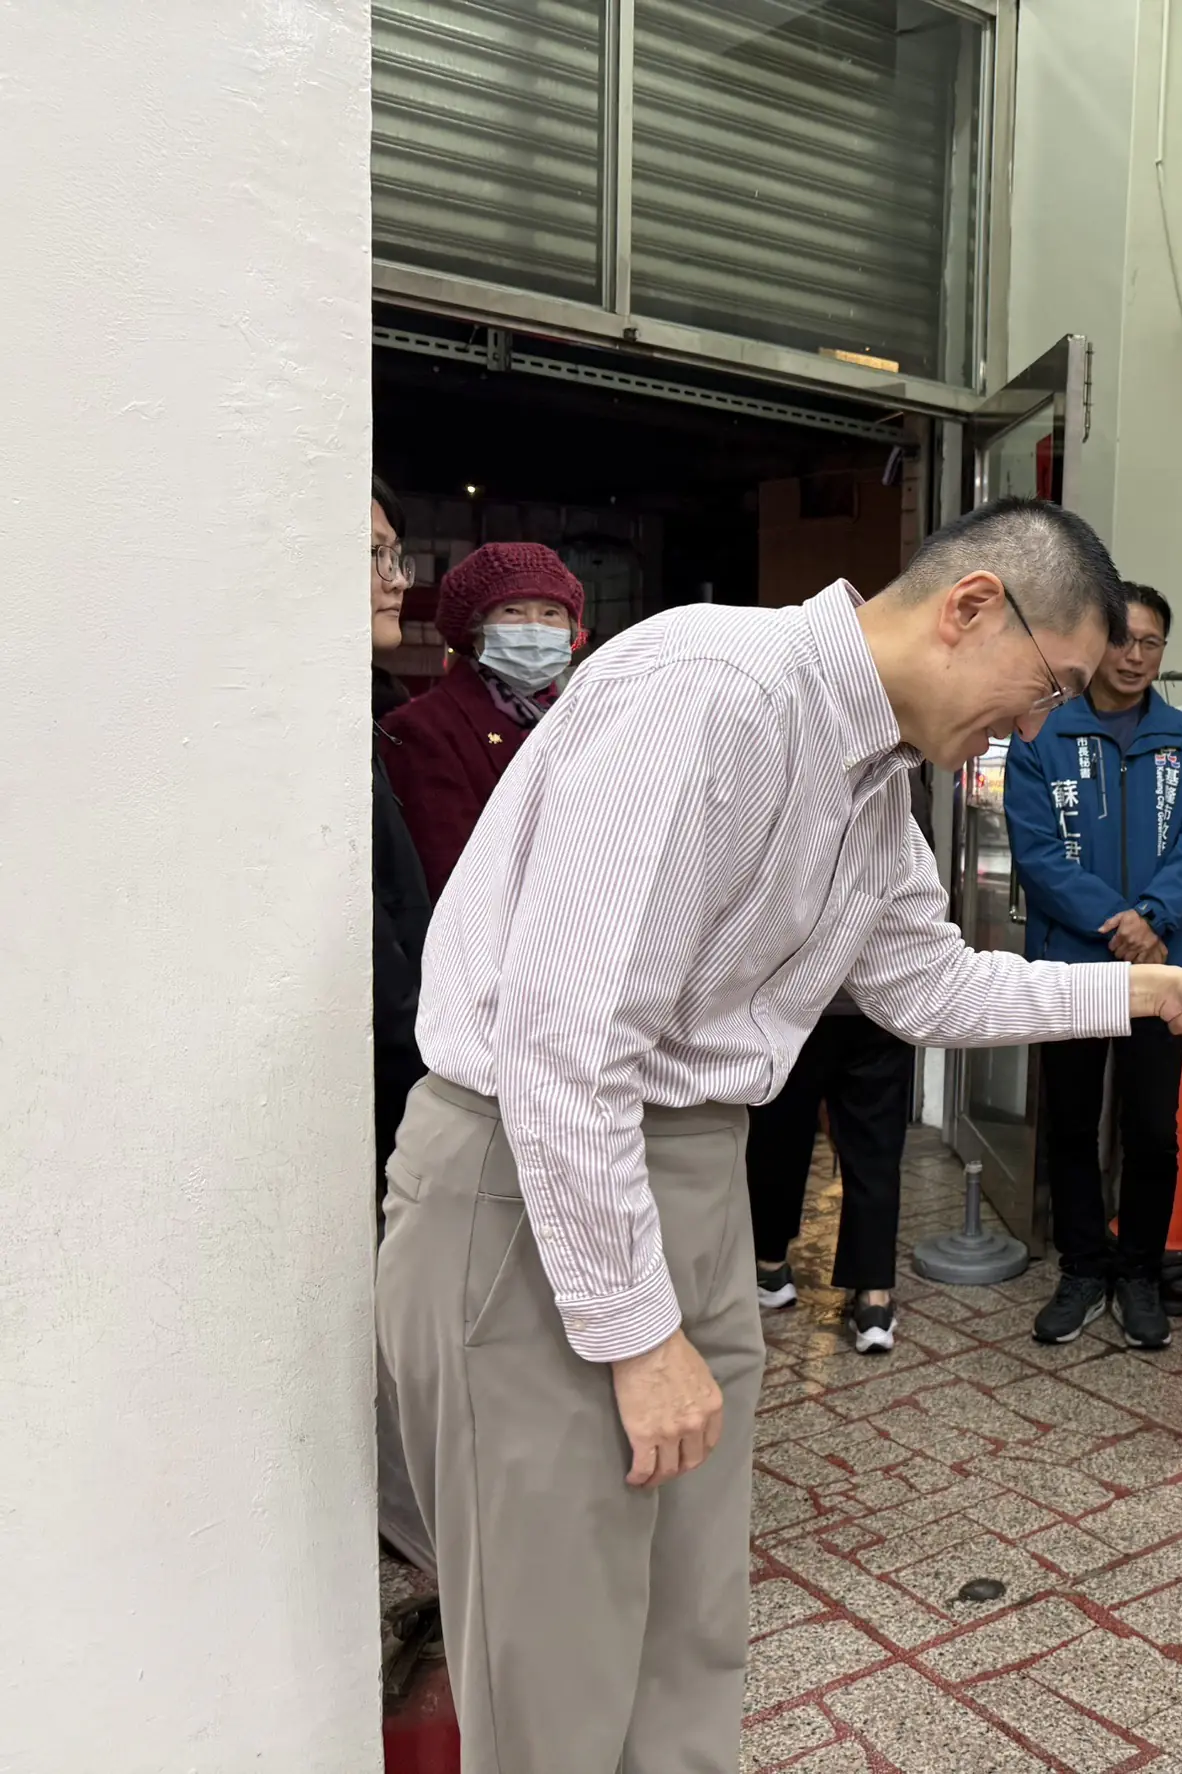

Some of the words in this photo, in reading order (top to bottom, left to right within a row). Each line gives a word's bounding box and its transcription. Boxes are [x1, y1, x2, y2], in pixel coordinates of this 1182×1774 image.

[1076, 737, 1091, 779] 市長秘書
[1155, 766, 1165, 794] Keelung
[1156, 796, 1164, 809] City
